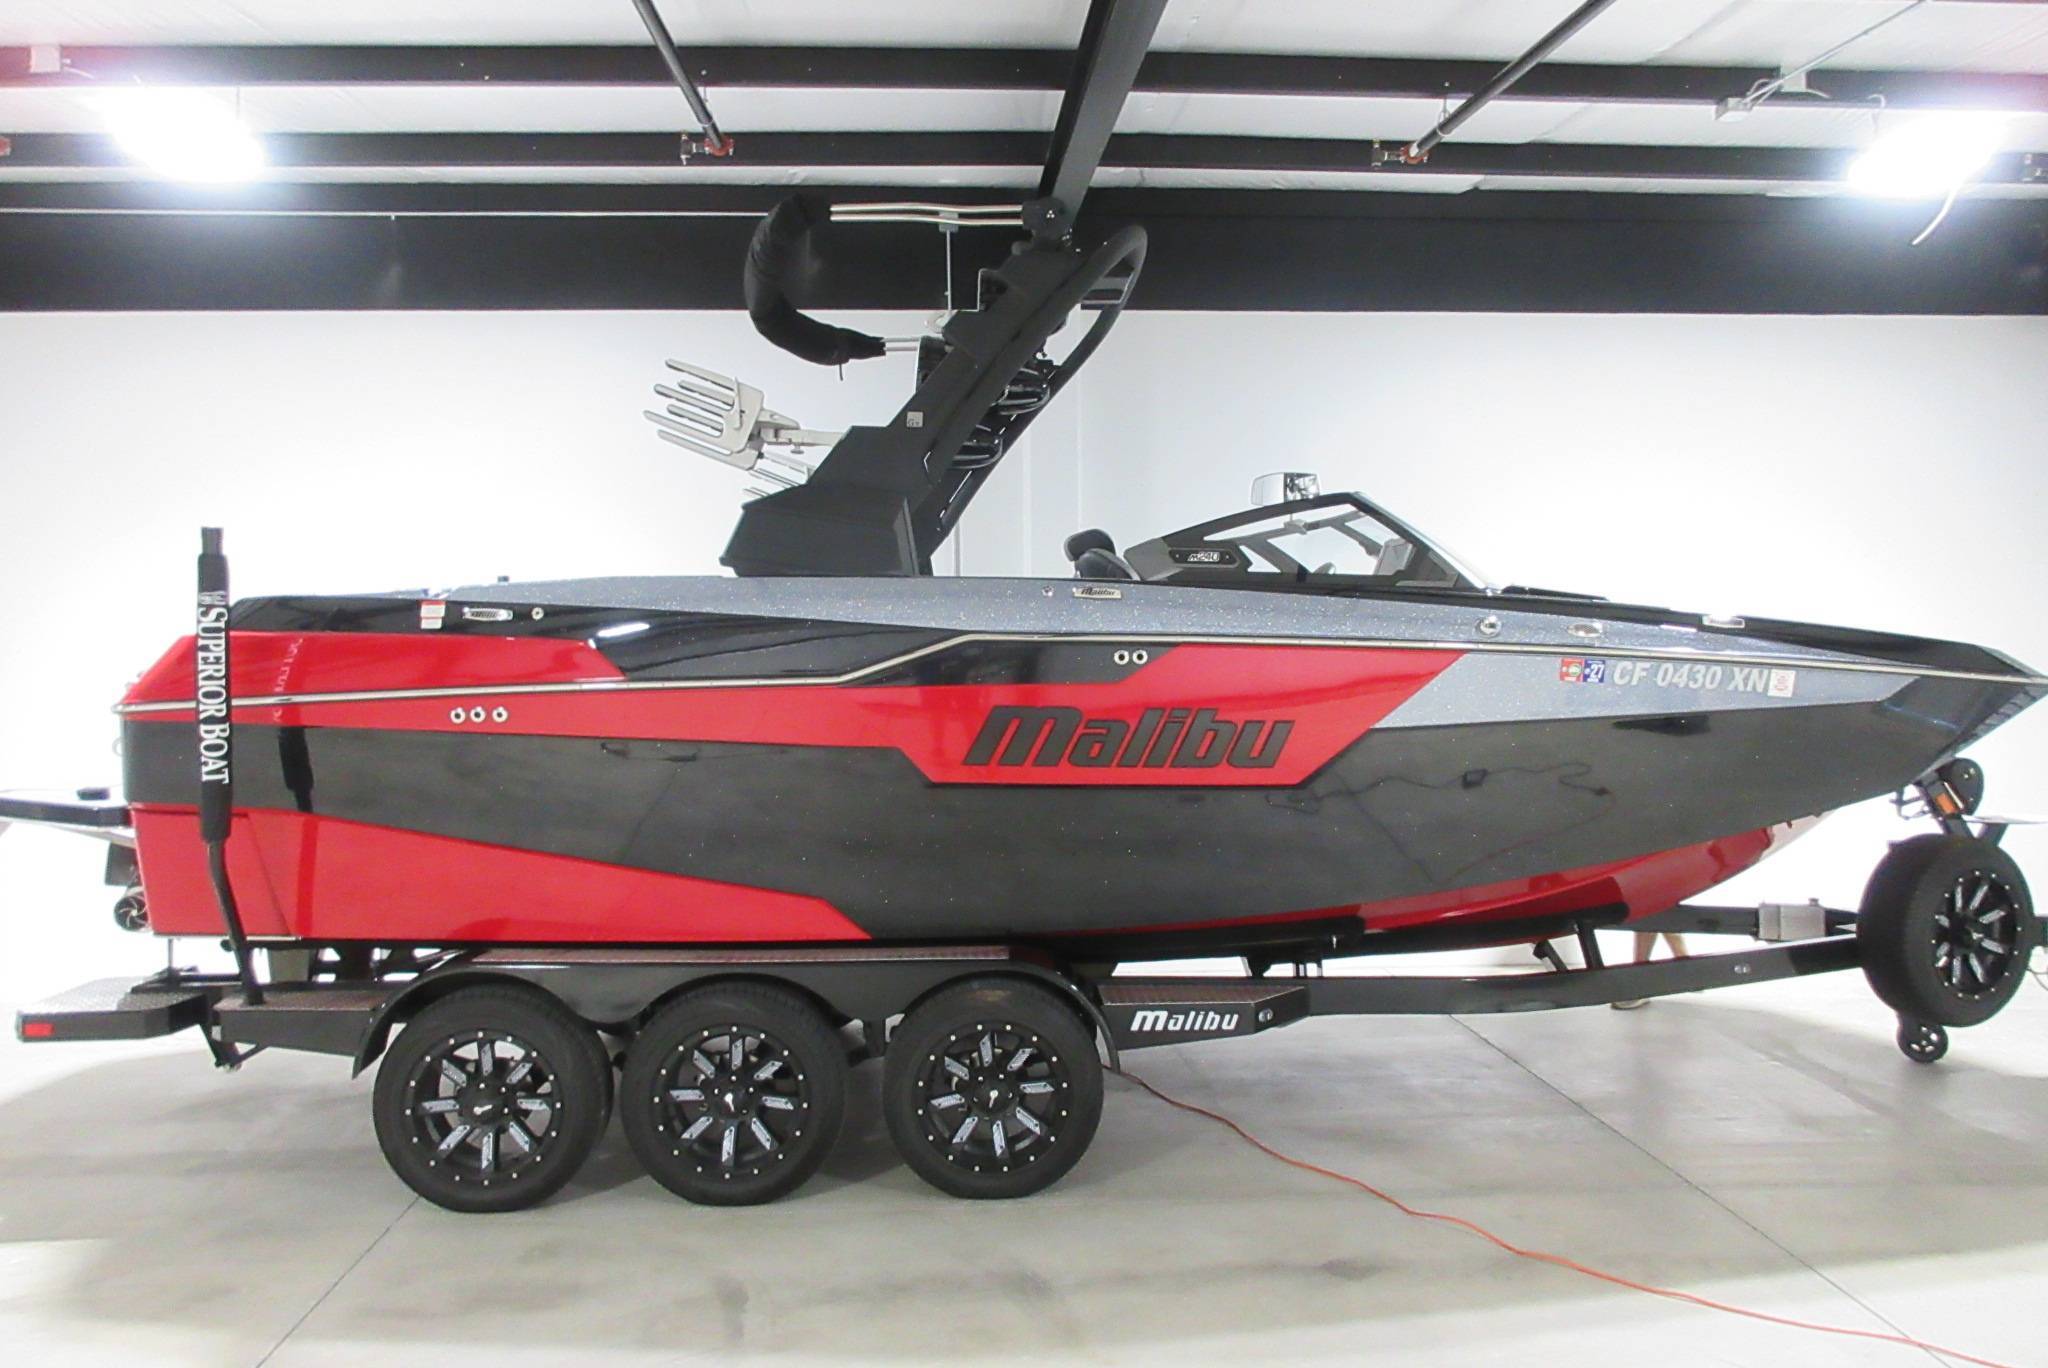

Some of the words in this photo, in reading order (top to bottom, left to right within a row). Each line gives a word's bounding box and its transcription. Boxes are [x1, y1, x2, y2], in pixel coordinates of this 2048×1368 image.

[198, 607, 228, 720] SUPERIOR
[1590, 663, 1605, 679] 27
[1613, 661, 1651, 685] CF
[1656, 662, 1722, 690] 0430
[1727, 667, 1769, 693] XN
[200, 722, 230, 784] BOAT
[962, 705, 1295, 769] Malibu
[1130, 1010, 1239, 1032] Malibu
